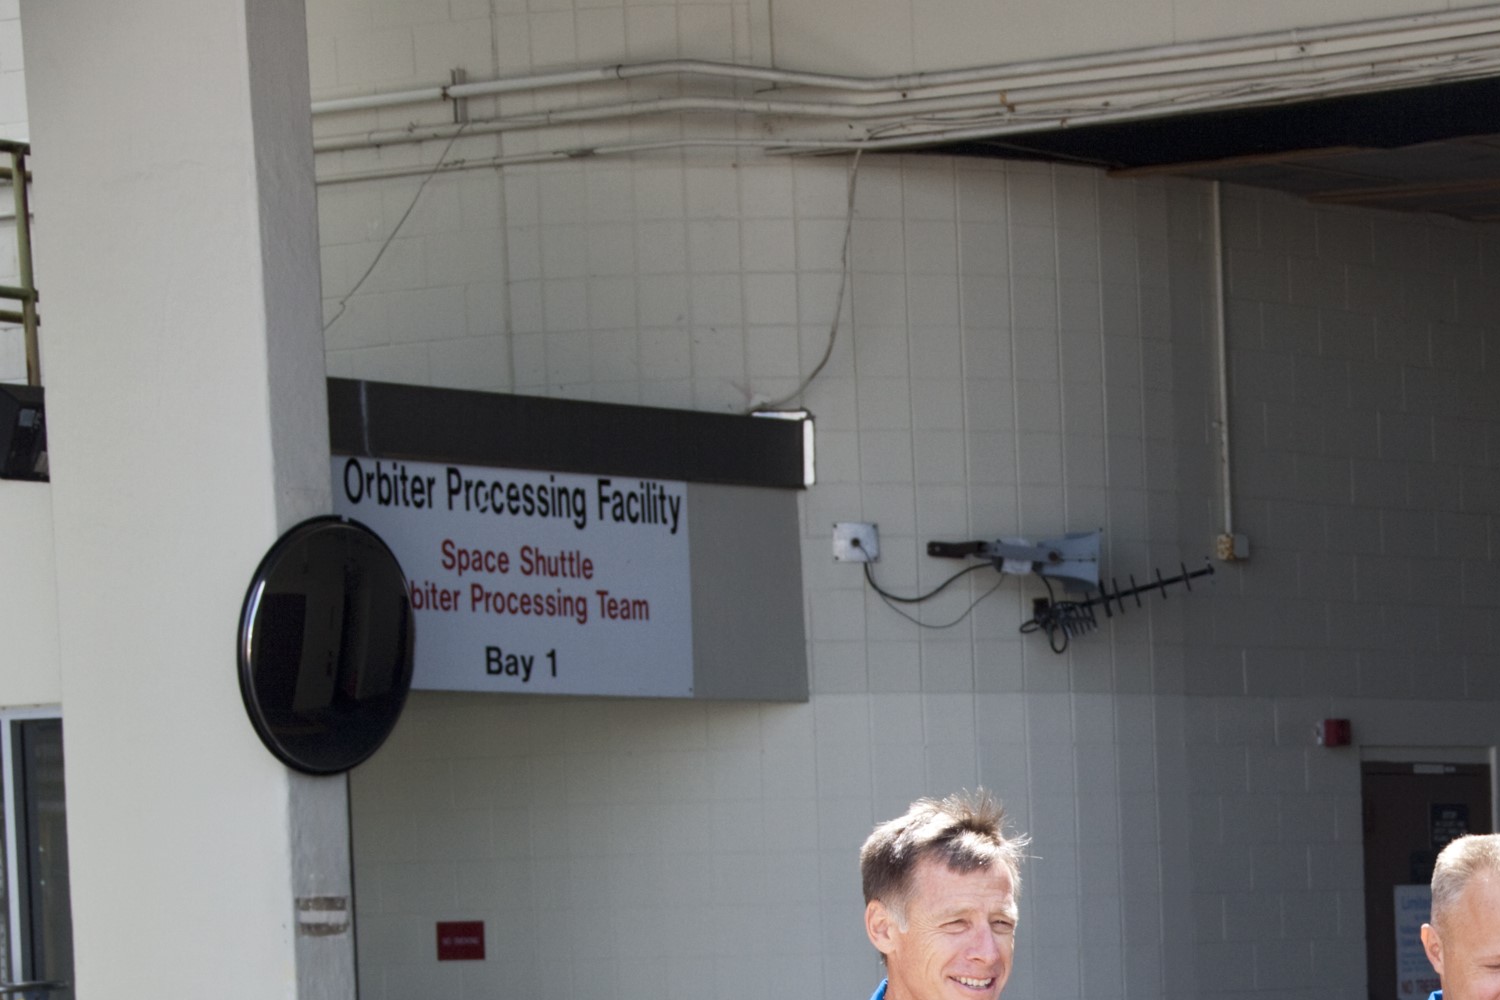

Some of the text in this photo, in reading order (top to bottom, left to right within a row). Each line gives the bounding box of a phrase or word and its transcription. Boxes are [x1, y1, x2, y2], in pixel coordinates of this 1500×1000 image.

[344, 457, 681, 534] Orbiter Processing Facility
[441, 539, 594, 579] Space Shuttle
[410, 580, 650, 625] biter Processing Team
[485, 646, 557, 682] Bay 1
